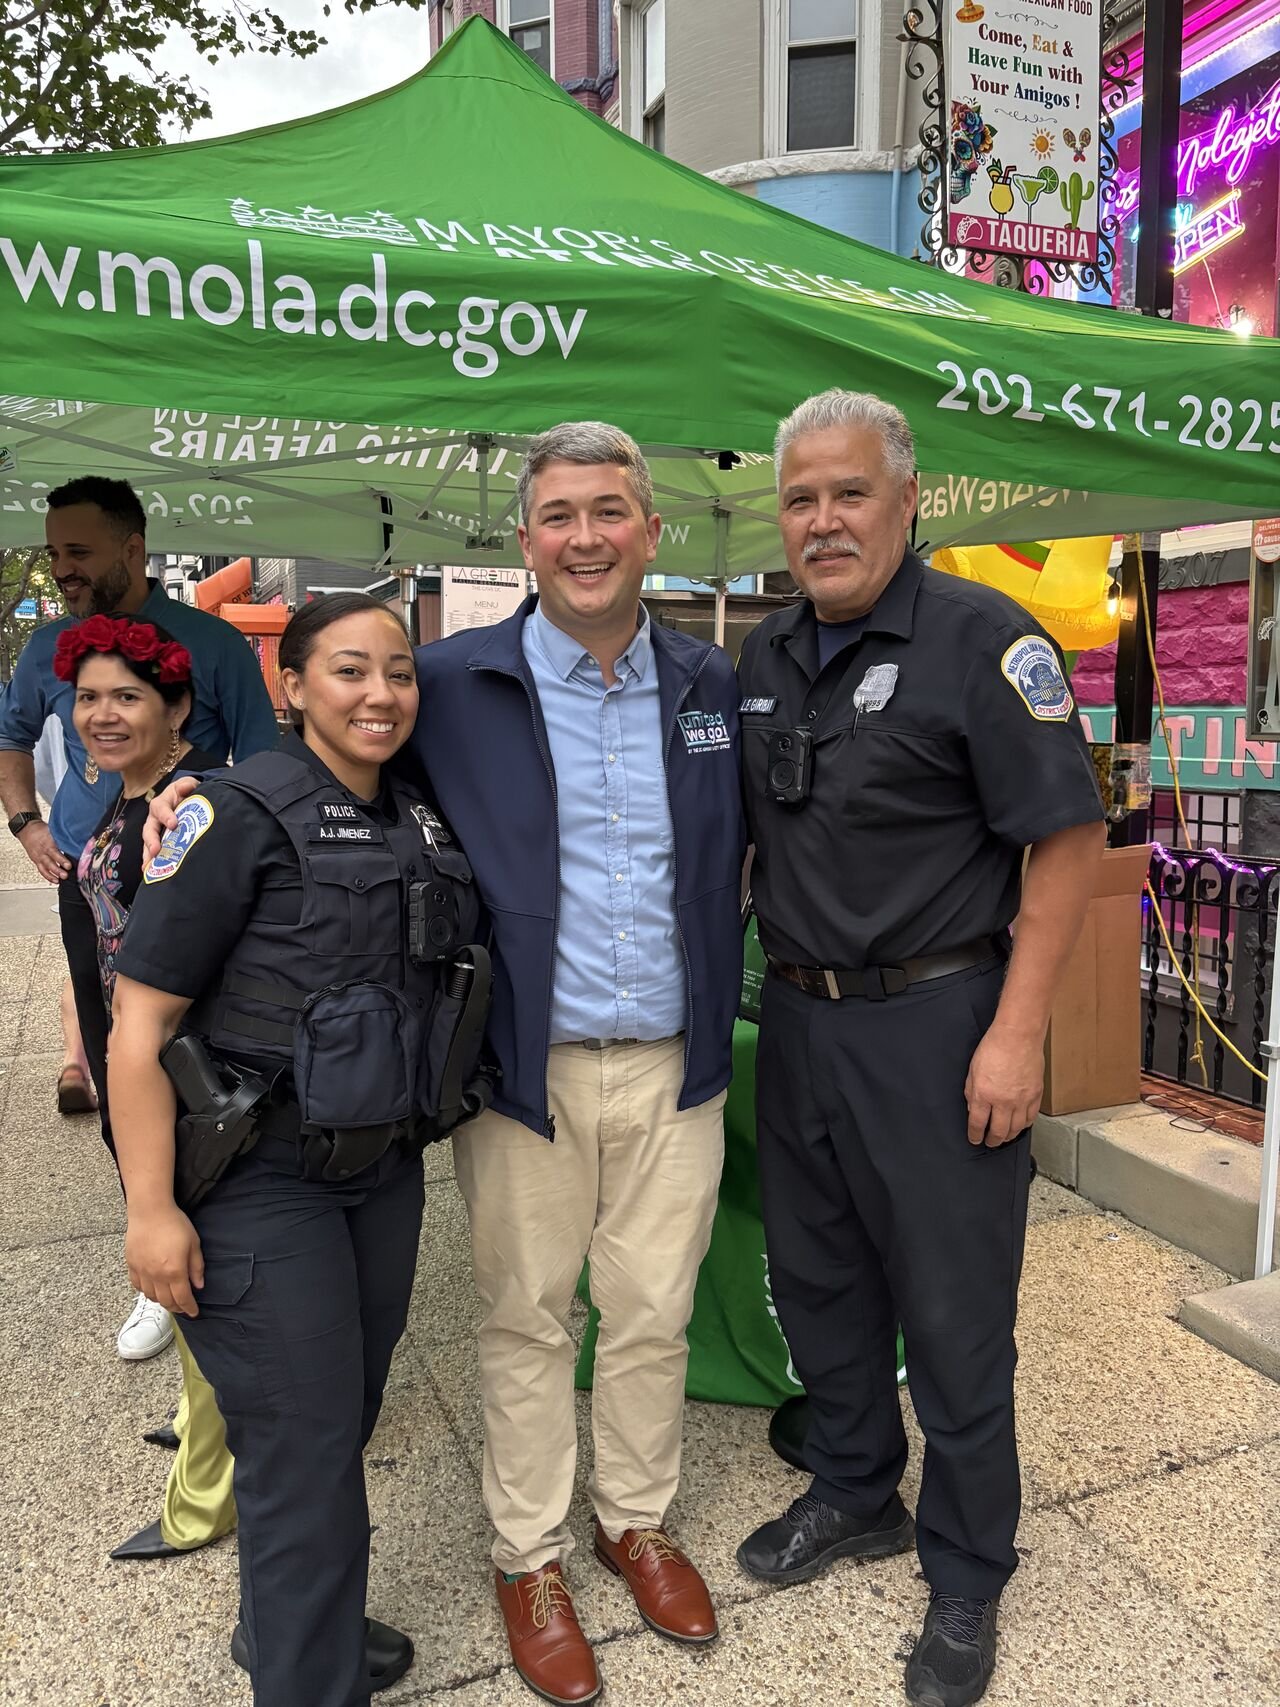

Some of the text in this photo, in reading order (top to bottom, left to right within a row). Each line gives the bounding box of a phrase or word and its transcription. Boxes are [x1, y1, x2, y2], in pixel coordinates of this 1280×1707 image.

[1068, 0, 1092, 16] FOOD
[978, 23, 1074, 58] Come, Eat &
[967, 47, 1083, 86] Have Fun with
[970, 74, 1009, 97] Your
[1013, 82, 1071, 110] Amigos
[986, 219, 1090, 260] TAQUERIA
[415, 218, 692, 262] MAYOR'S
[700, 250, 895, 302] OFFICE
[887, 286, 977, 313] ON
[0, 237, 588, 379] w.mola.dc.gov
[451, 567, 519, 582] LA GROTTA
[1158, 551, 1228, 590] 2307
[474, 601, 499, 609] MENU
[681, 711, 724, 729] united
[686, 729, 706, 742] we
[324, 805, 356, 818] POLICE
[320, 827, 371, 840] A.J. JIMENEZ
